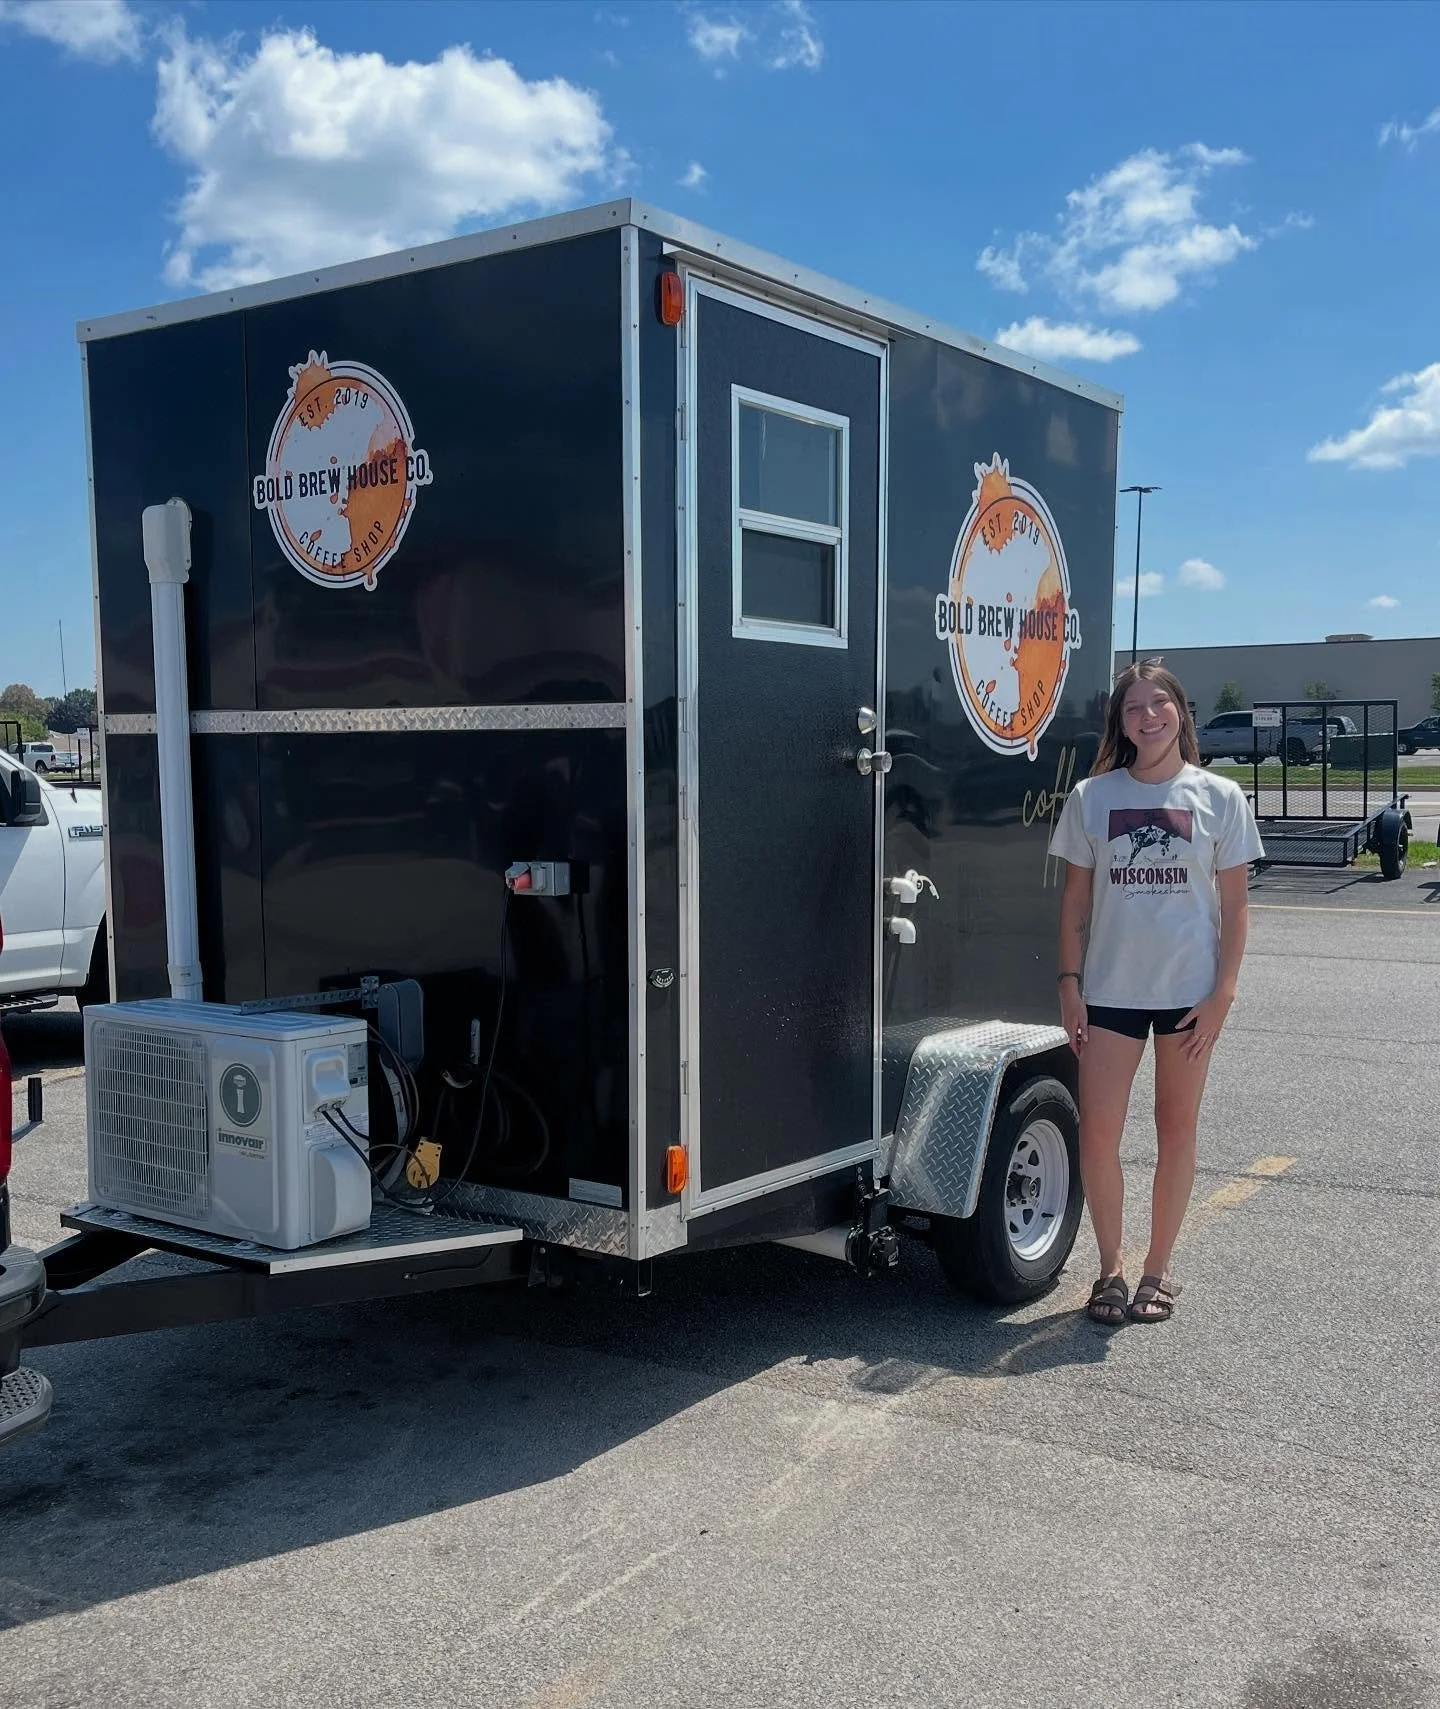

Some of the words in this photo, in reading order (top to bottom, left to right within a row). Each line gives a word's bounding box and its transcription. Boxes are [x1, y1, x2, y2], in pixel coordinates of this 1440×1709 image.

[299, 397, 328, 427] EST.
[336, 387, 369, 409] 2019
[256, 475, 293, 504] BOLD
[299, 467, 341, 498] BREW
[347, 459, 399, 490] HOUSE
[406, 454, 430, 482] CO.
[299, 531, 347, 569] COFFEE
[353, 520, 384, 563] SHOP
[981, 512, 1007, 546] EST.
[1013, 511, 1040, 545] 2019
[939, 600, 973, 635] BOLD
[978, 604, 1015, 638] BREW
[1019, 608, 1059, 641] HOUSE
[1063, 613, 1080, 643] CO.
[976, 679, 1015, 731] COFFEE
[1020, 680, 1045, 726] SHOP
[1022, 746, 1077, 889] coff
[1110, 867, 1188, 885] WISCONSIN
[218, 1127, 264, 1149] innovair
